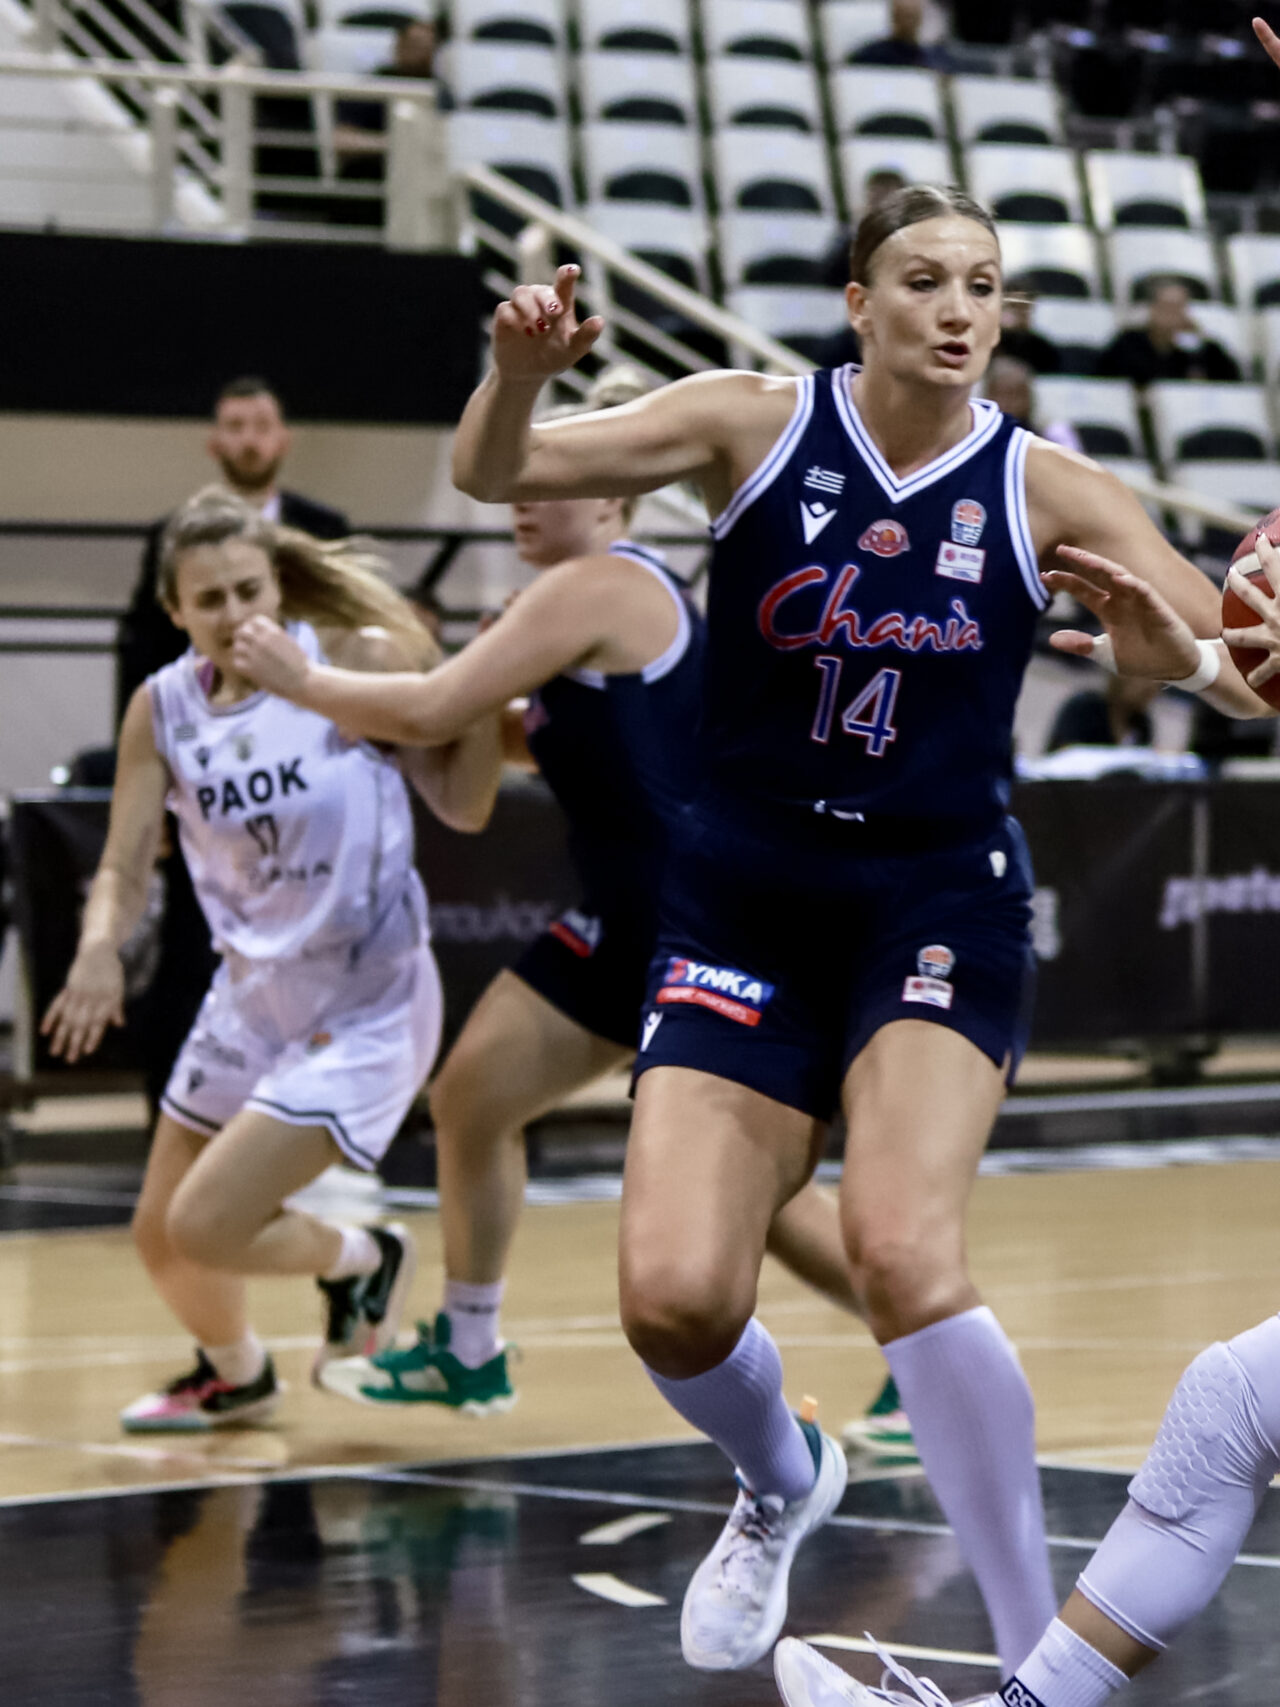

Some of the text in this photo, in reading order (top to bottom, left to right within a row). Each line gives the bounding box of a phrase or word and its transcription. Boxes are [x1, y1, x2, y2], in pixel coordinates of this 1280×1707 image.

[811, 655, 901, 757] 14
[197, 757, 309, 821] PAOK
[665, 958, 764, 1004] SYNKA
